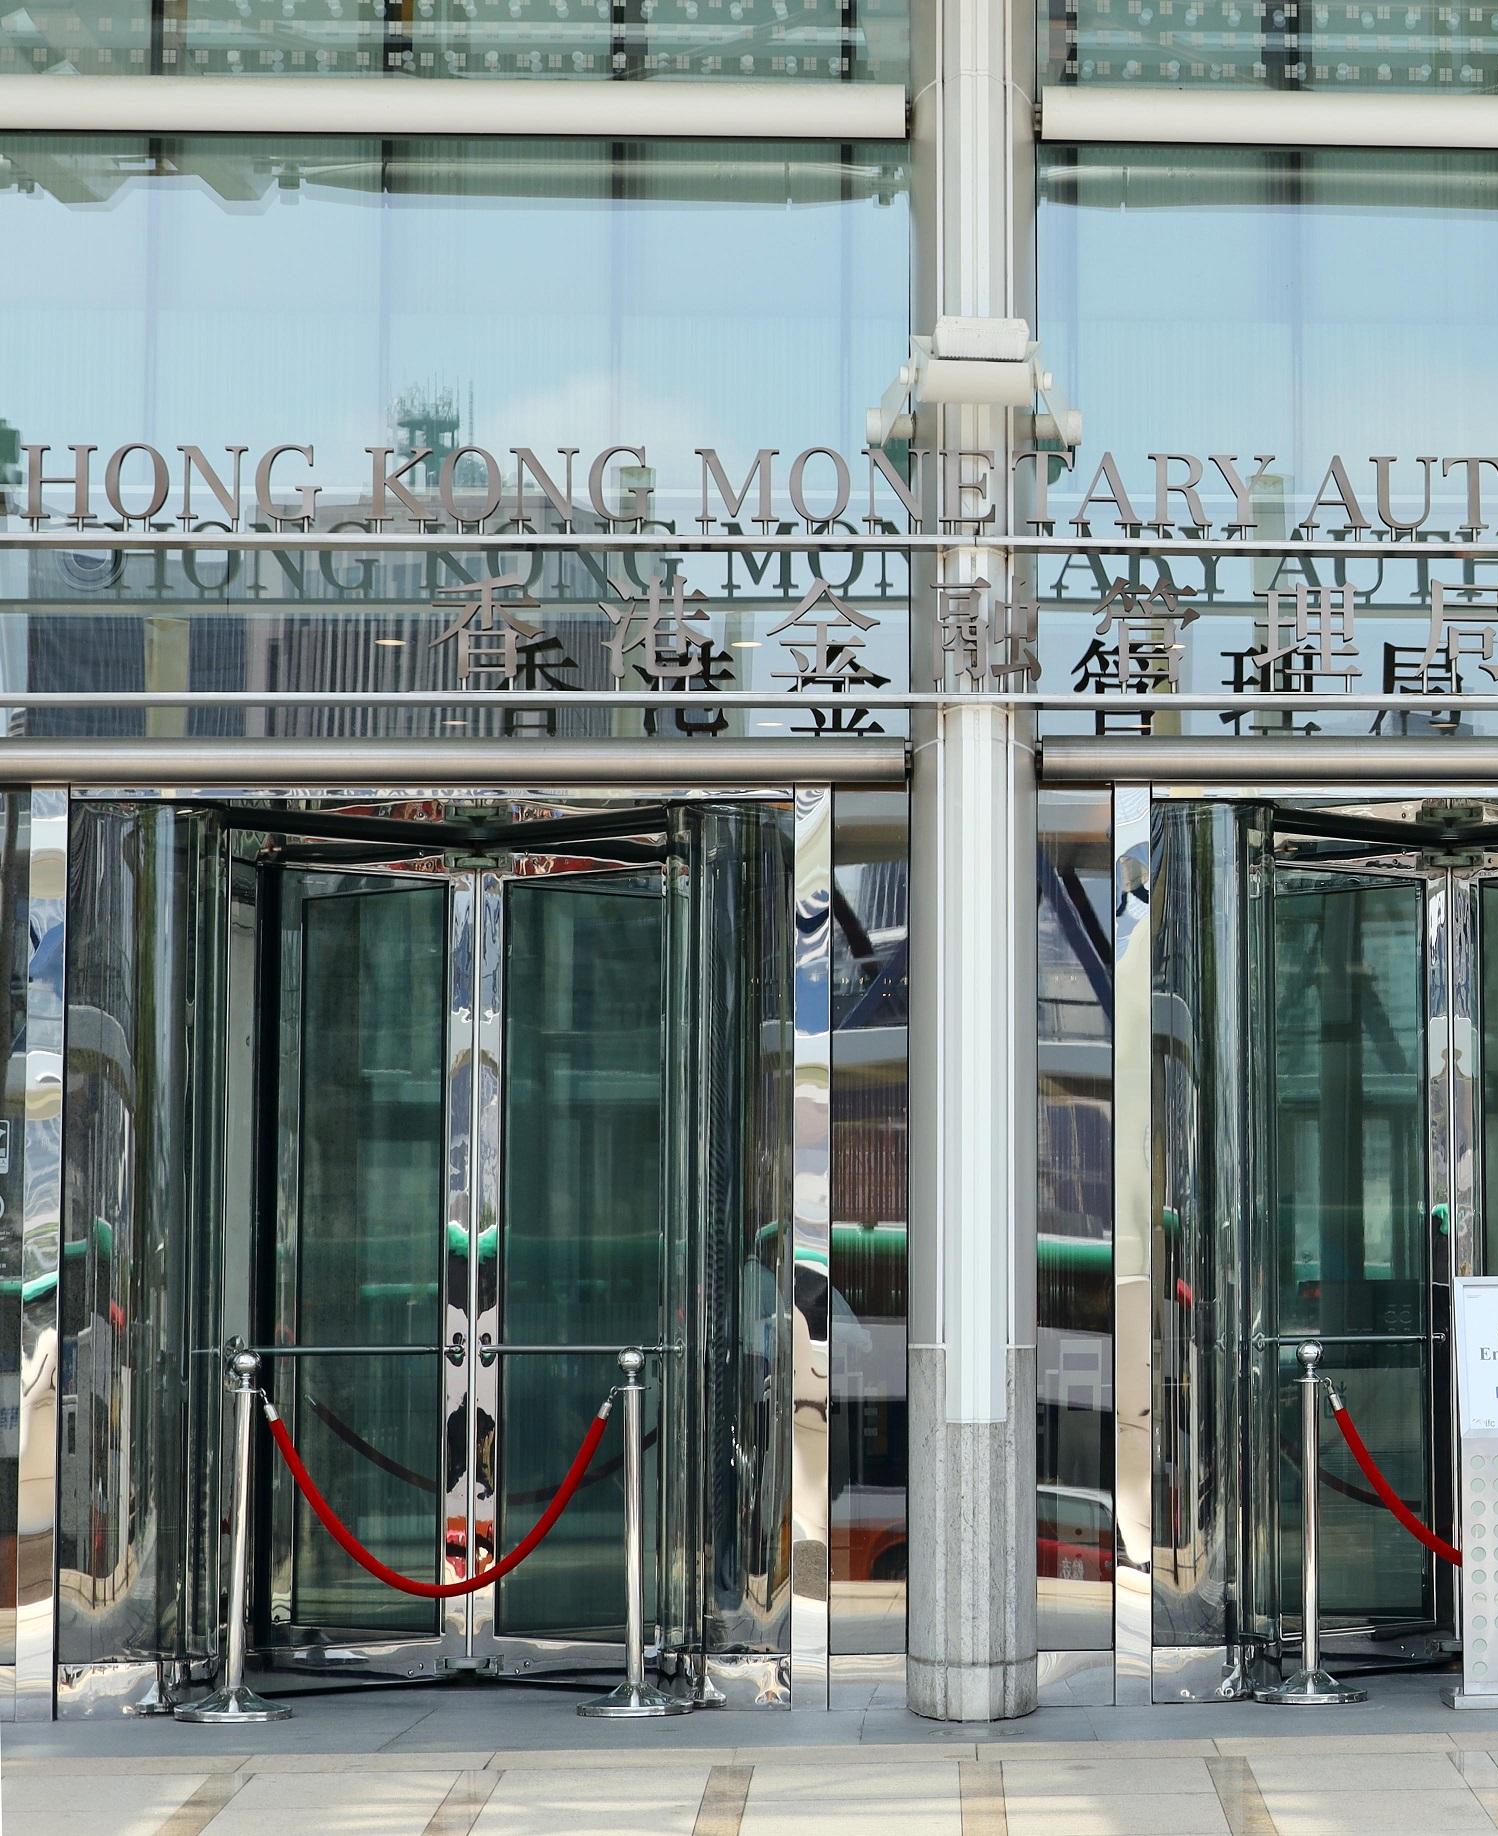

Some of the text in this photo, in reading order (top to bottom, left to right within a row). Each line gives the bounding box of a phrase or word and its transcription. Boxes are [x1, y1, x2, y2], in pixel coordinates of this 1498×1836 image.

[20, 443, 322, 521] HONG
[364, 445, 655, 523] KONG
[694, 446, 1276, 528] MONETARY
